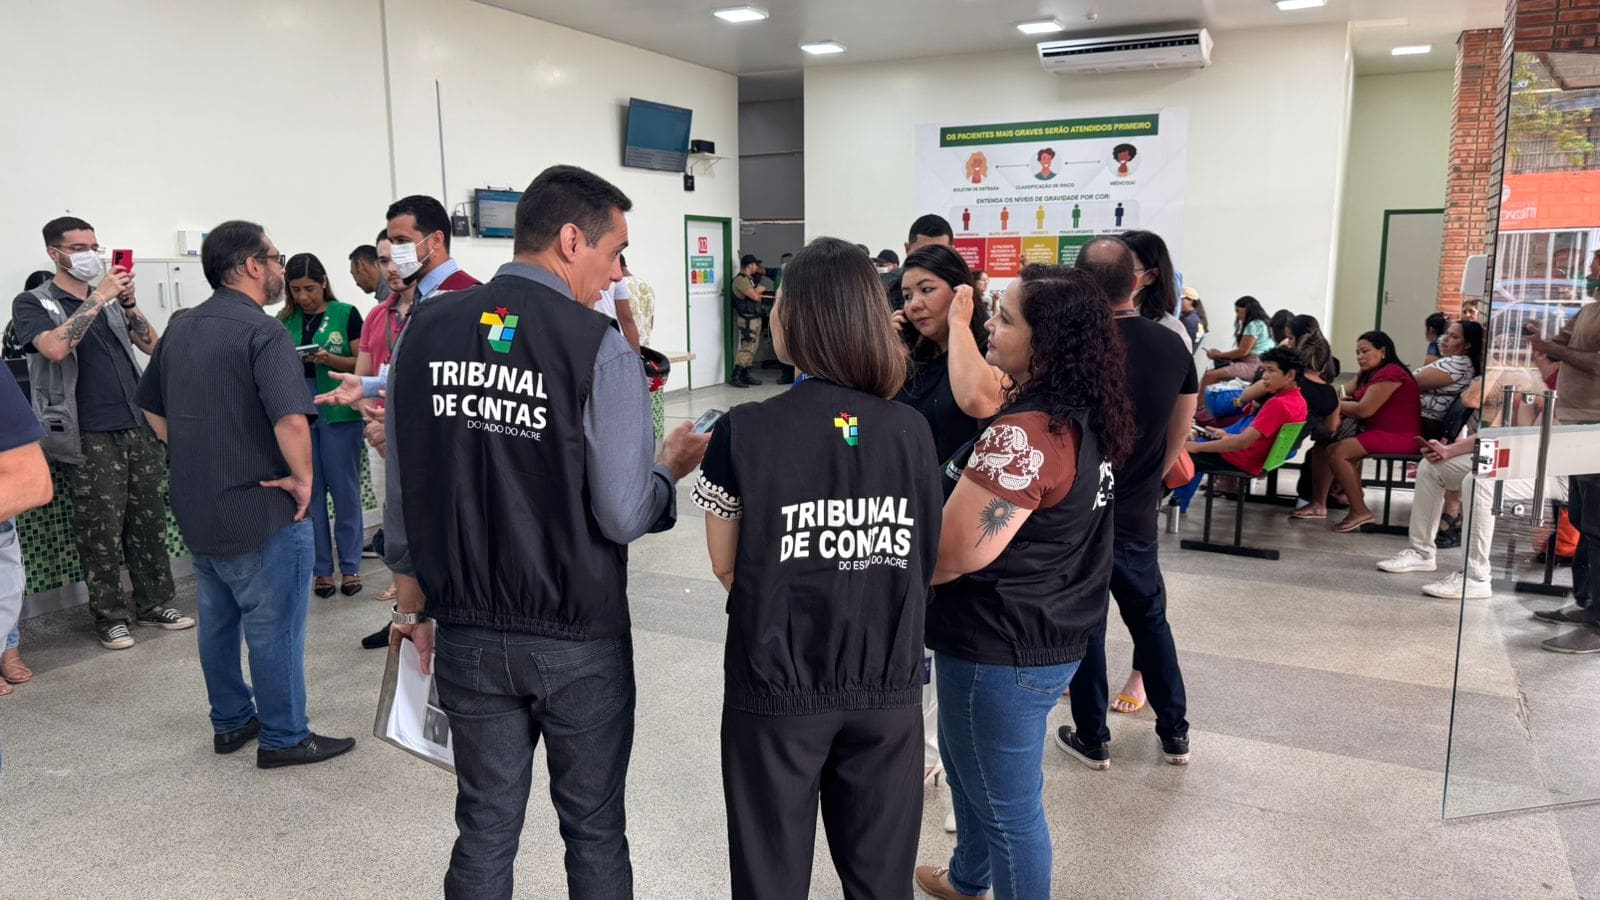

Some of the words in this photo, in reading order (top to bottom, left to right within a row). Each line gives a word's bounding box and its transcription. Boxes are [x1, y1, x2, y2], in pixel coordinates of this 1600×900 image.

[957, 131, 994, 141] PACIENTES
[996, 130, 1014, 138] MAIS
[1015, 128, 1044, 136] GRAVES
[1045, 125, 1069, 135] SERÃO
[1071, 124, 1112, 133] ATENDIDOS
[1114, 121, 1152, 131] PRIMEIRO
[1015, 182, 1052, 190] CLASSIFICAÇÃO
[432, 394, 457, 417] DE
[467, 420, 481, 429] DO
[505, 426, 519, 436] DO
[519, 429, 541, 441] ACRE
[781, 496, 914, 532] TRIBUNAL
[780, 531, 810, 563] DE
[839, 560, 851, 570] DO
[871, 555, 883, 564] DO
[884, 556, 908, 569] ACRE
